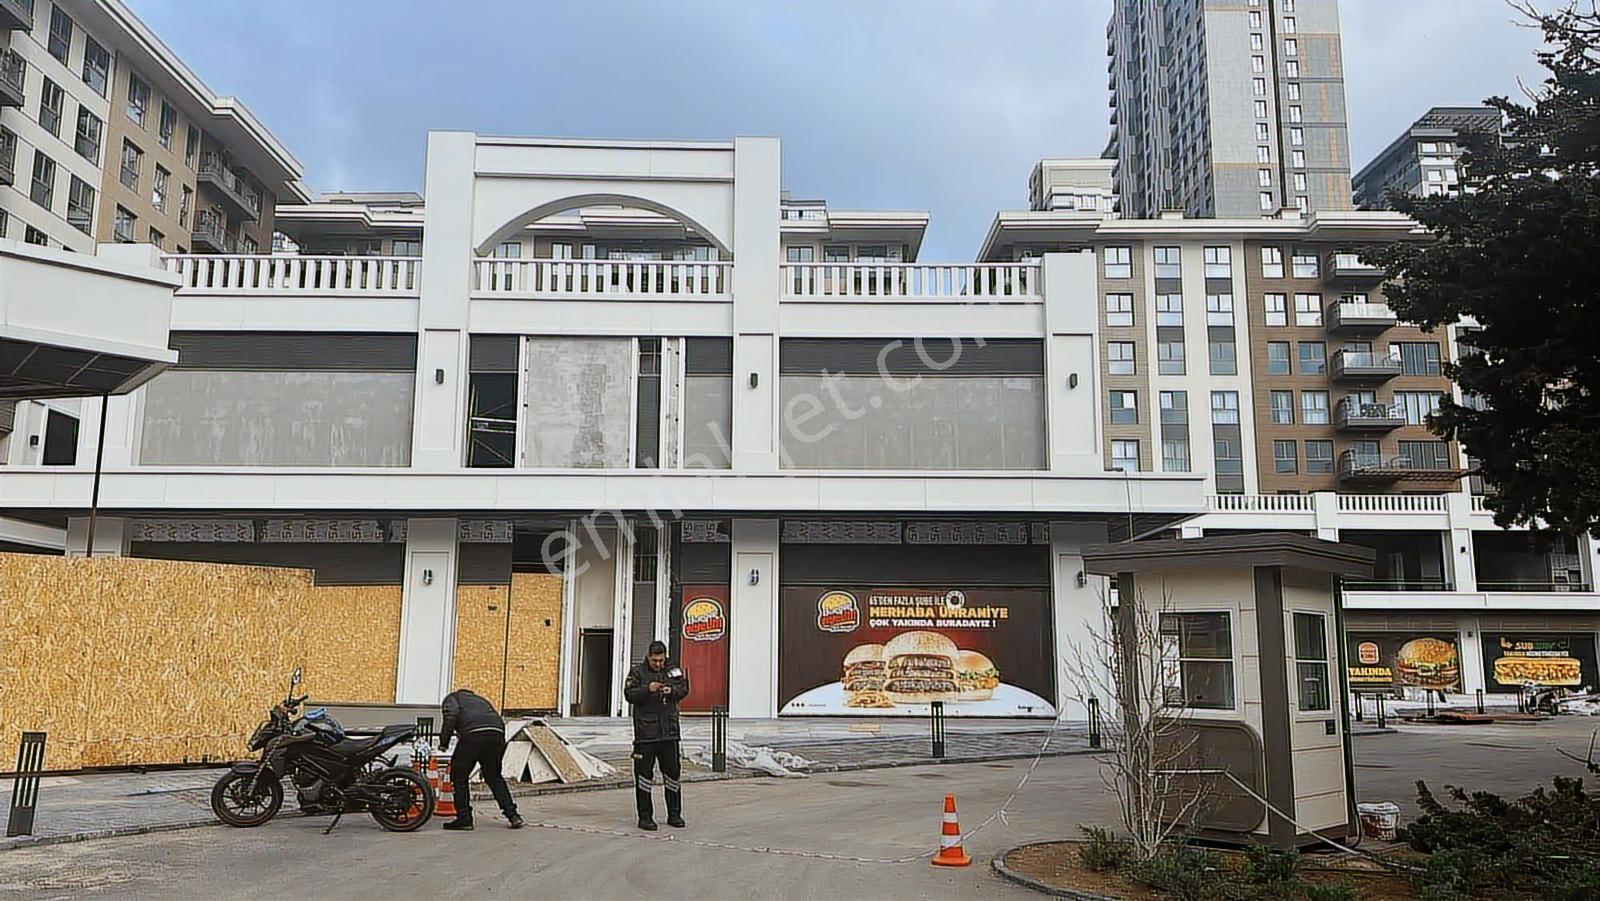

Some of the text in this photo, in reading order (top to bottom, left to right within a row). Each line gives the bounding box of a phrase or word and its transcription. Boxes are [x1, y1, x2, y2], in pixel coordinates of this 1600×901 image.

[869, 607, 935, 618] MERHABA
[939, 605, 1009, 619] ÜMRANİYE
[869, 619, 889, 628] ÇOK
[892, 619, 934, 627] YAKINDA
[936, 619, 990, 627] BURADAYIZ
